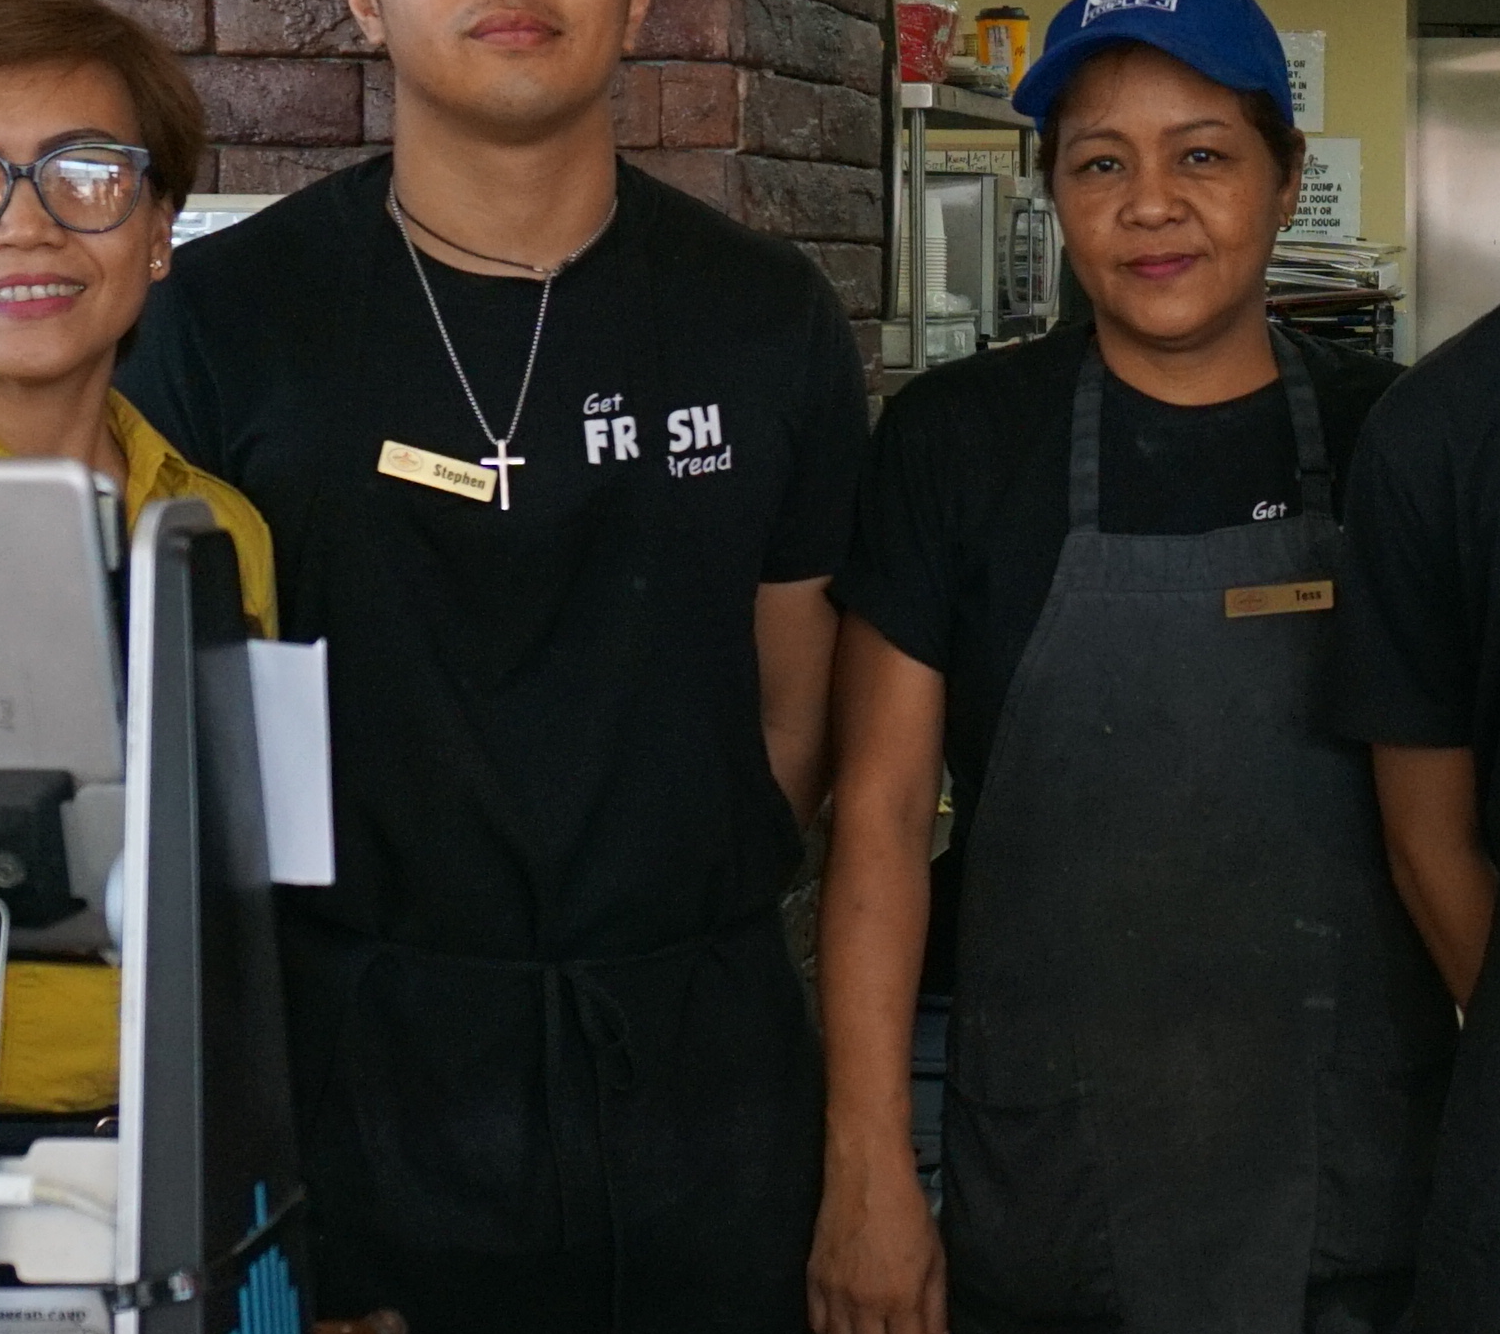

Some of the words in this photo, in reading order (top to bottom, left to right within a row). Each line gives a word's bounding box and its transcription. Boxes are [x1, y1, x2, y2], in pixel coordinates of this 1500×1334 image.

[1310, 182, 1334, 192] DUMP
[1336, 183, 1342, 192] A
[1309, 194, 1339, 204] DOUGH
[1319, 206, 1332, 215] OR
[1311, 218, 1341, 227] DOUGH
[582, 392, 625, 416] Get
[431, 462, 488, 493] Stephen
[1251, 500, 1289, 522] Get
[1295, 589, 1322, 602] Tess
